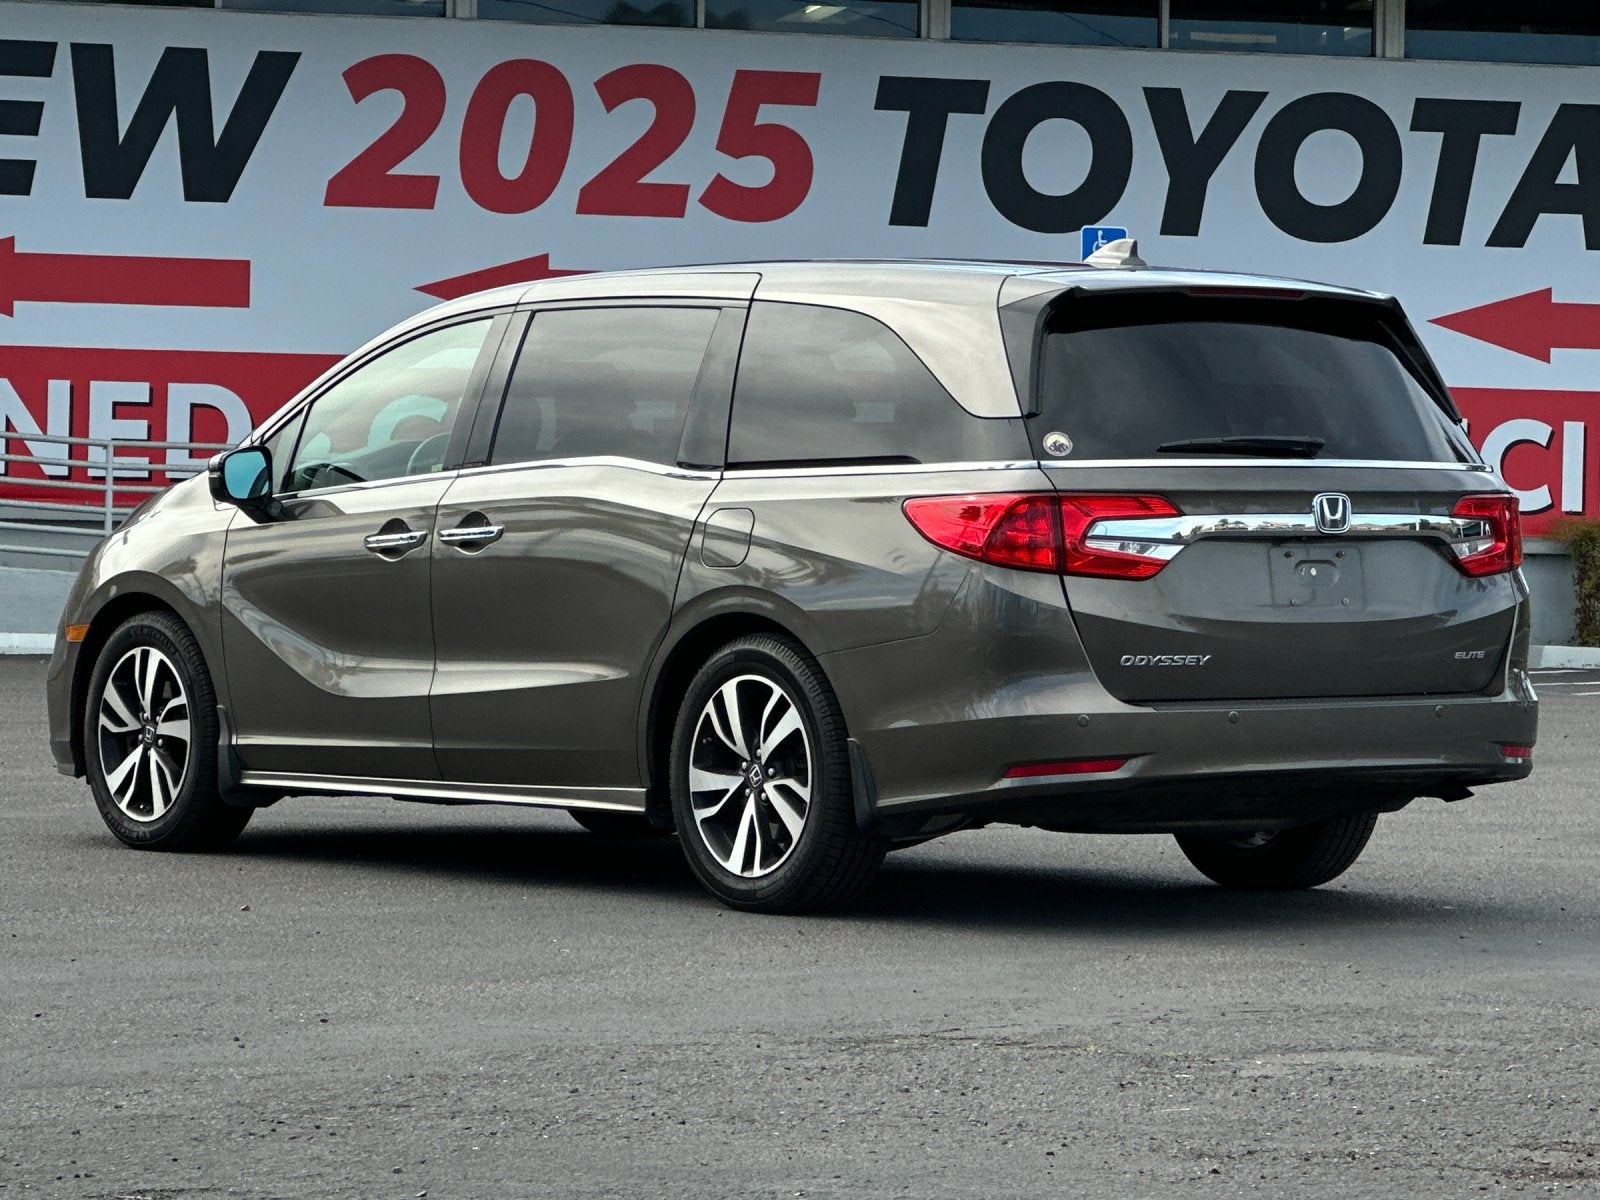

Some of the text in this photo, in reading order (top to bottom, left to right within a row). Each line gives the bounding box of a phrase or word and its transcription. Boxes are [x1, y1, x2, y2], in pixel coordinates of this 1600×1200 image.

[323, 53, 822, 223] 2025
[874, 75, 1600, 250] TOYOTA
[0, 378, 253, 479] NED
[1461, 418, 1585, 513] CI
[1120, 654, 1212, 667] ODYSSEY
[1454, 650, 1486, 660] ELITE
